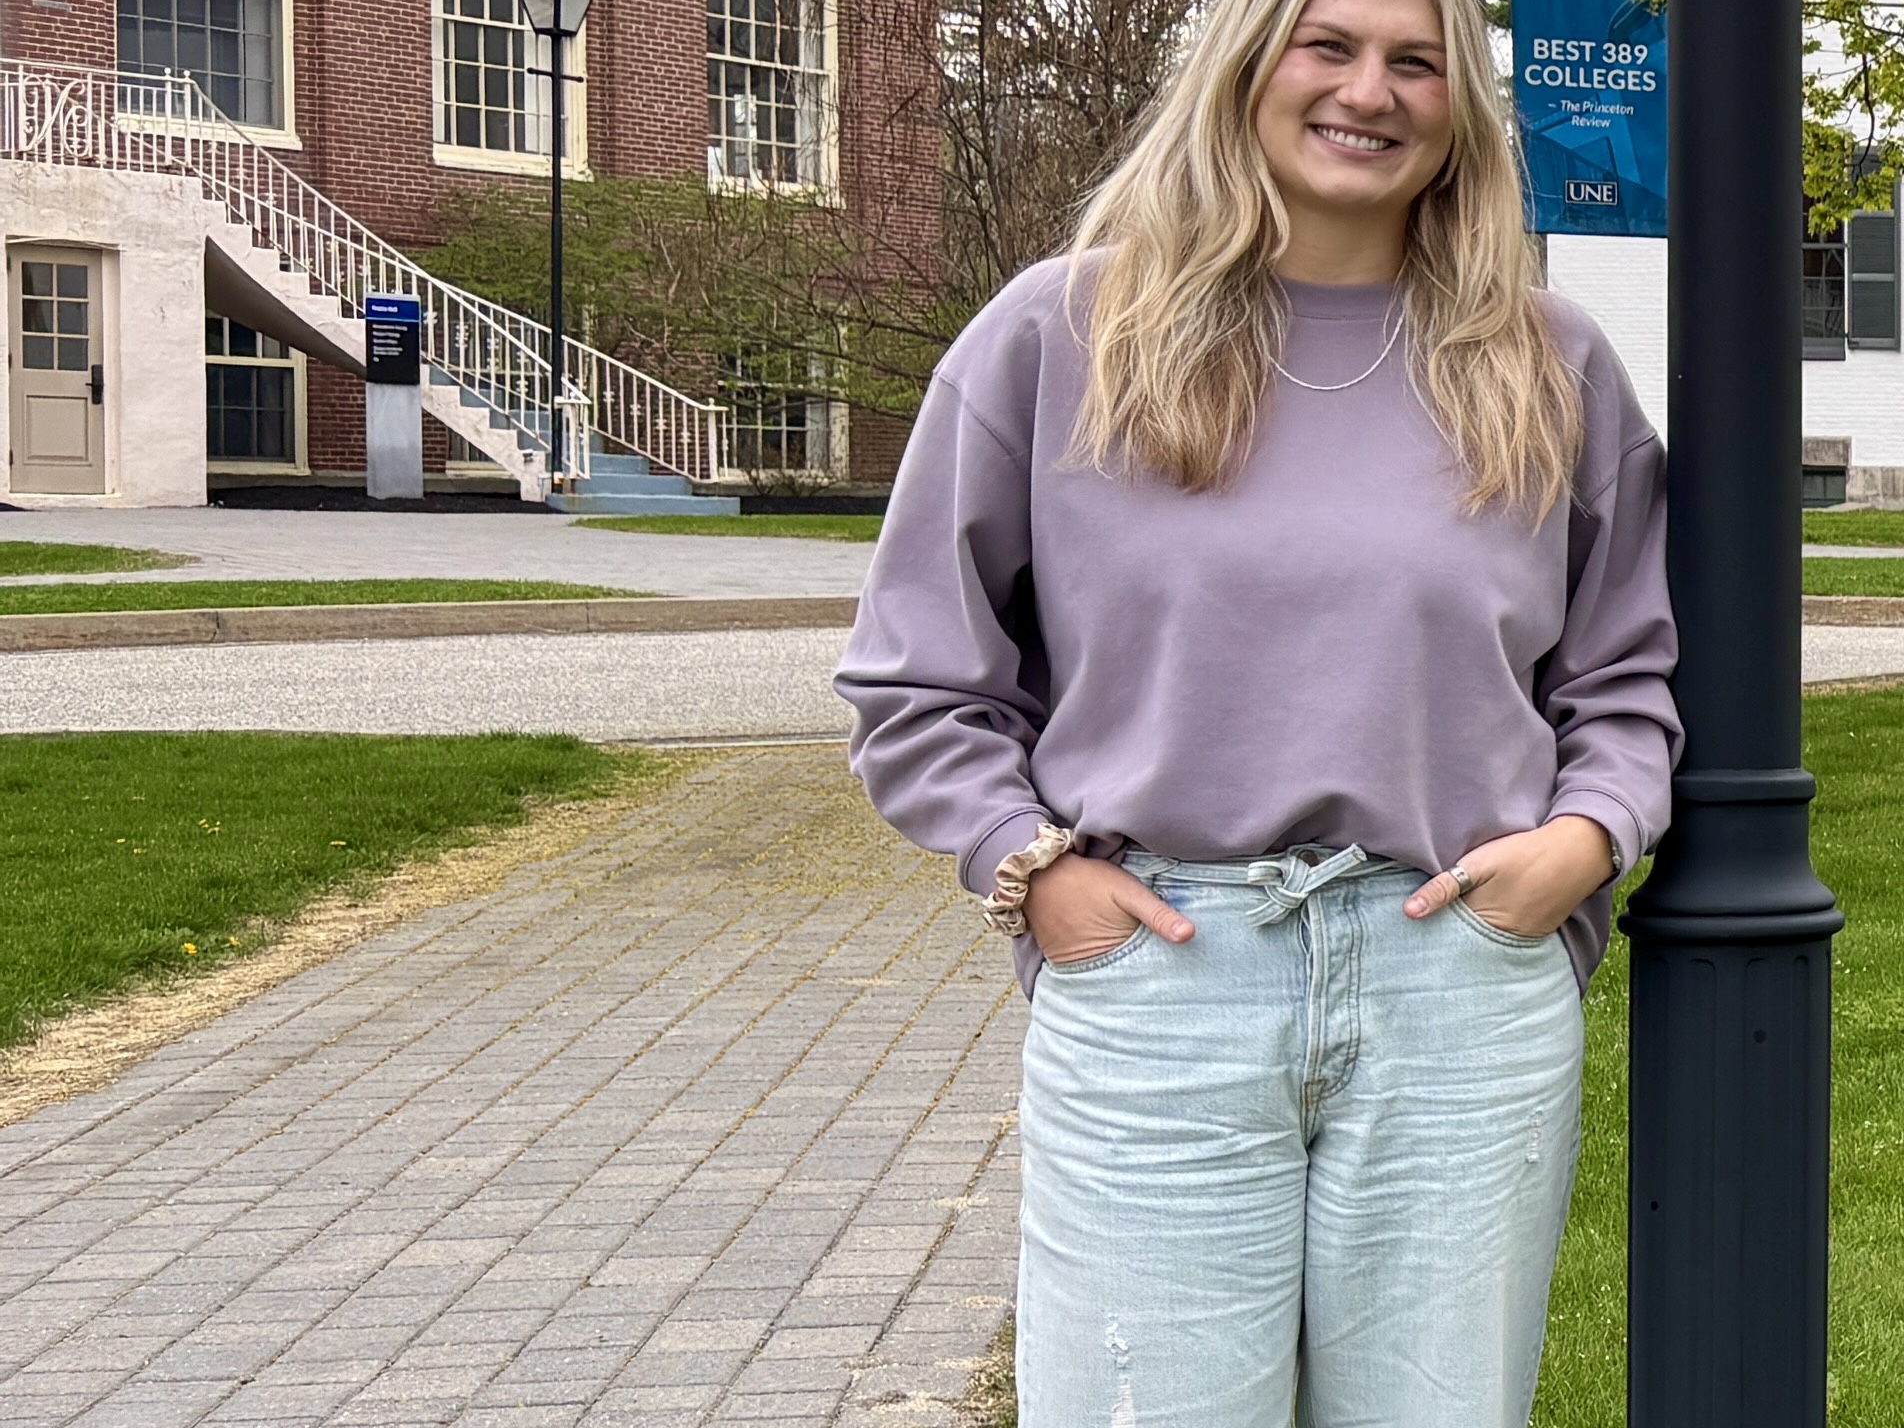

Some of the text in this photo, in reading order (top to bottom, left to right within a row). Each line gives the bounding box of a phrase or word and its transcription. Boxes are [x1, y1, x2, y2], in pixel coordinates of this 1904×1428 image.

[1533, 38, 1648, 65] BEST 389
[1524, 64, 1657, 92] COLLEGES
[1560, 99, 1580, 113] The
[1582, 100, 1635, 116] Princeton
[1571, 115, 1611, 129] Review
[1569, 183, 1613, 203] UNE
